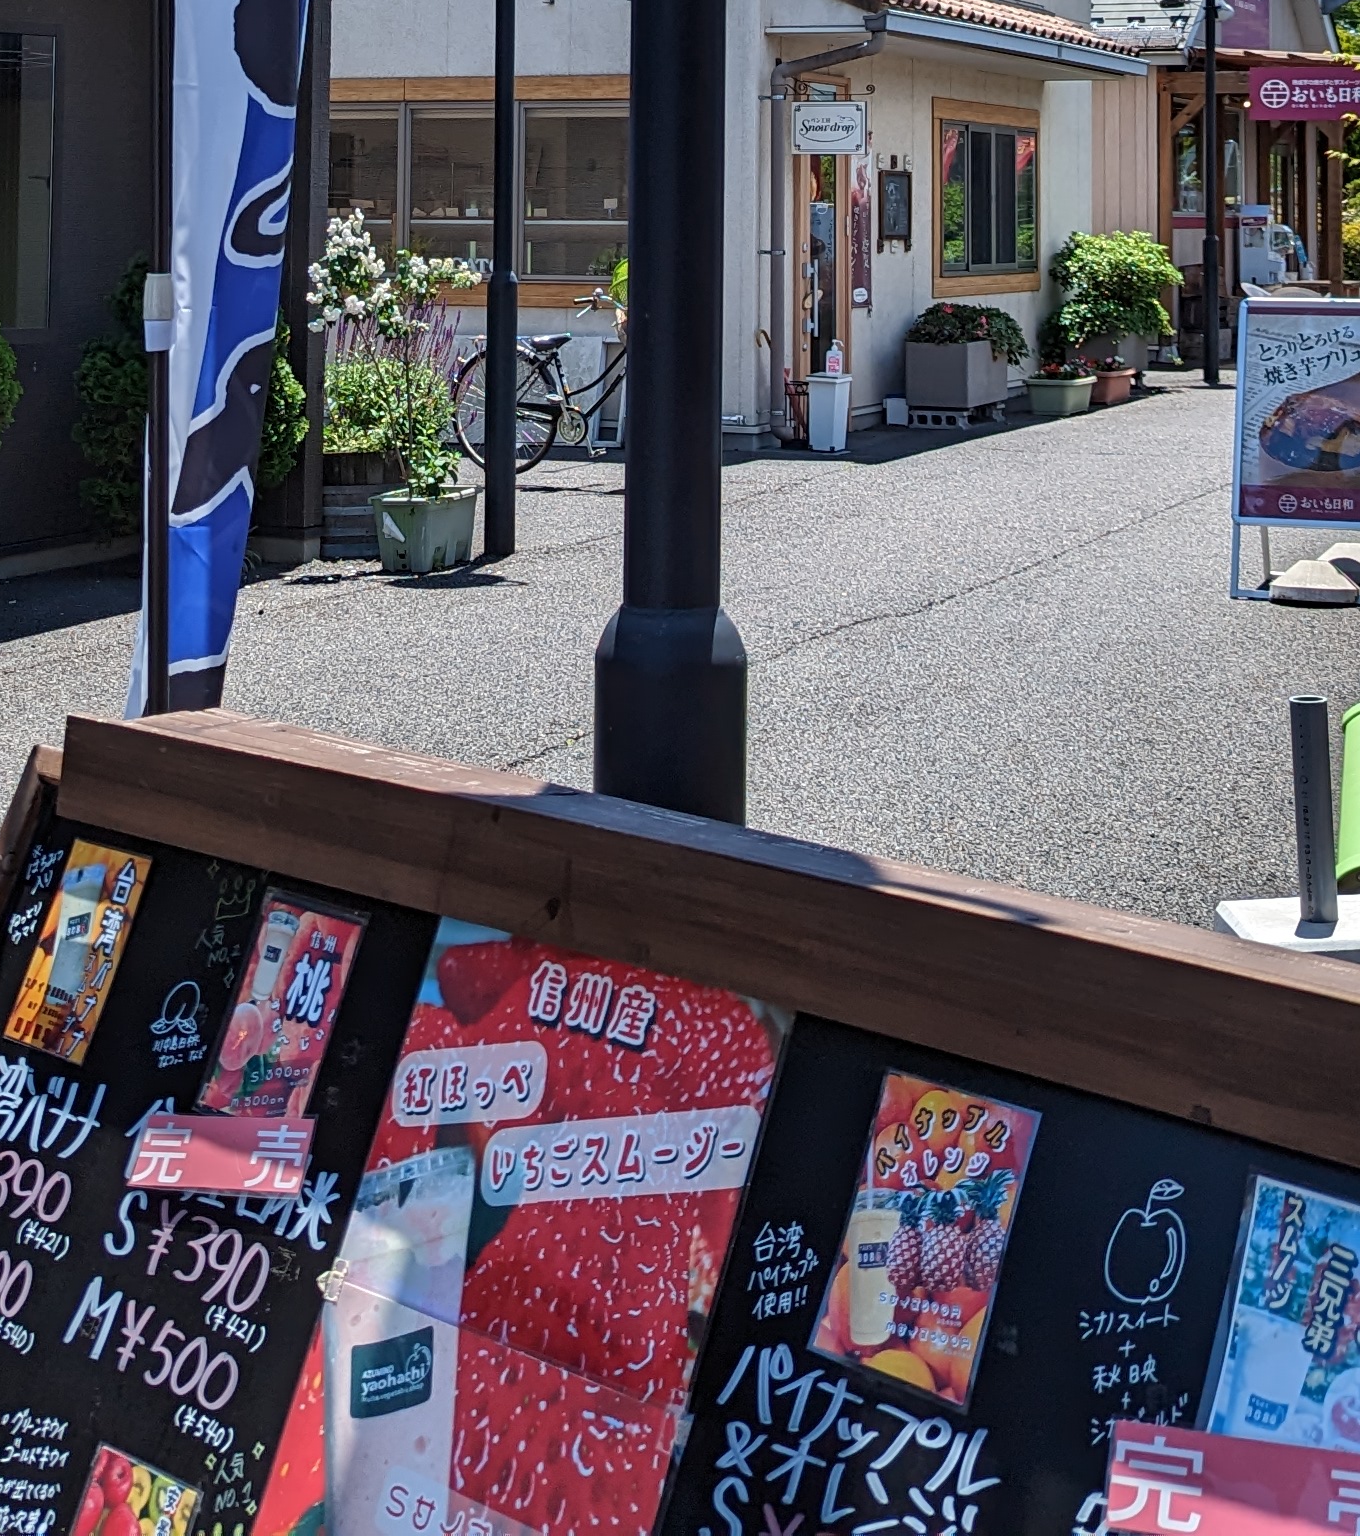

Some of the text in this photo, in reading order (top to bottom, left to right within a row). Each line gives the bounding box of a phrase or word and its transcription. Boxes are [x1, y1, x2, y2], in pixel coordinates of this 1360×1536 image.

[1258, 325, 1355, 362] とろりとろける
[1300, 496, 1354, 511] おいも日和
[64, 858, 137, 1057] 台湾バナナ
[310, 930, 338, 954] 信州
[286, 952, 331, 1024] 桃
[526, 961, 656, 1046] 信州産
[400, 1064, 534, 1112] 紅ほっぺ
[133, 1121, 308, 1190] 完売
[490, 1125, 748, 1192] いちごスムージー
[874, 1105, 1011, 1178] パイナップル
[900, 1146, 990, 1188] オレンジ
[15, 1218, 71, 1262] (¥421)
[103, 1189, 149, 1257] S
[146, 1198, 272, 1313] ¥390
[753, 1220, 805, 1262] 台湾
[747, 1248, 820, 1292] パイナップル
[1079, 1303, 1180, 1340] シナノスイート
[1303, 1243, 1356, 1354] 三兄弟
[62, 1275, 241, 1411] M ¥500
[203, 1304, 268, 1354] (¥421)
[361, 1363, 425, 1396] yaohachi
[173, 1403, 236, 1454] (¥540)
[716, 1342, 1001, 1496] パイナップル
